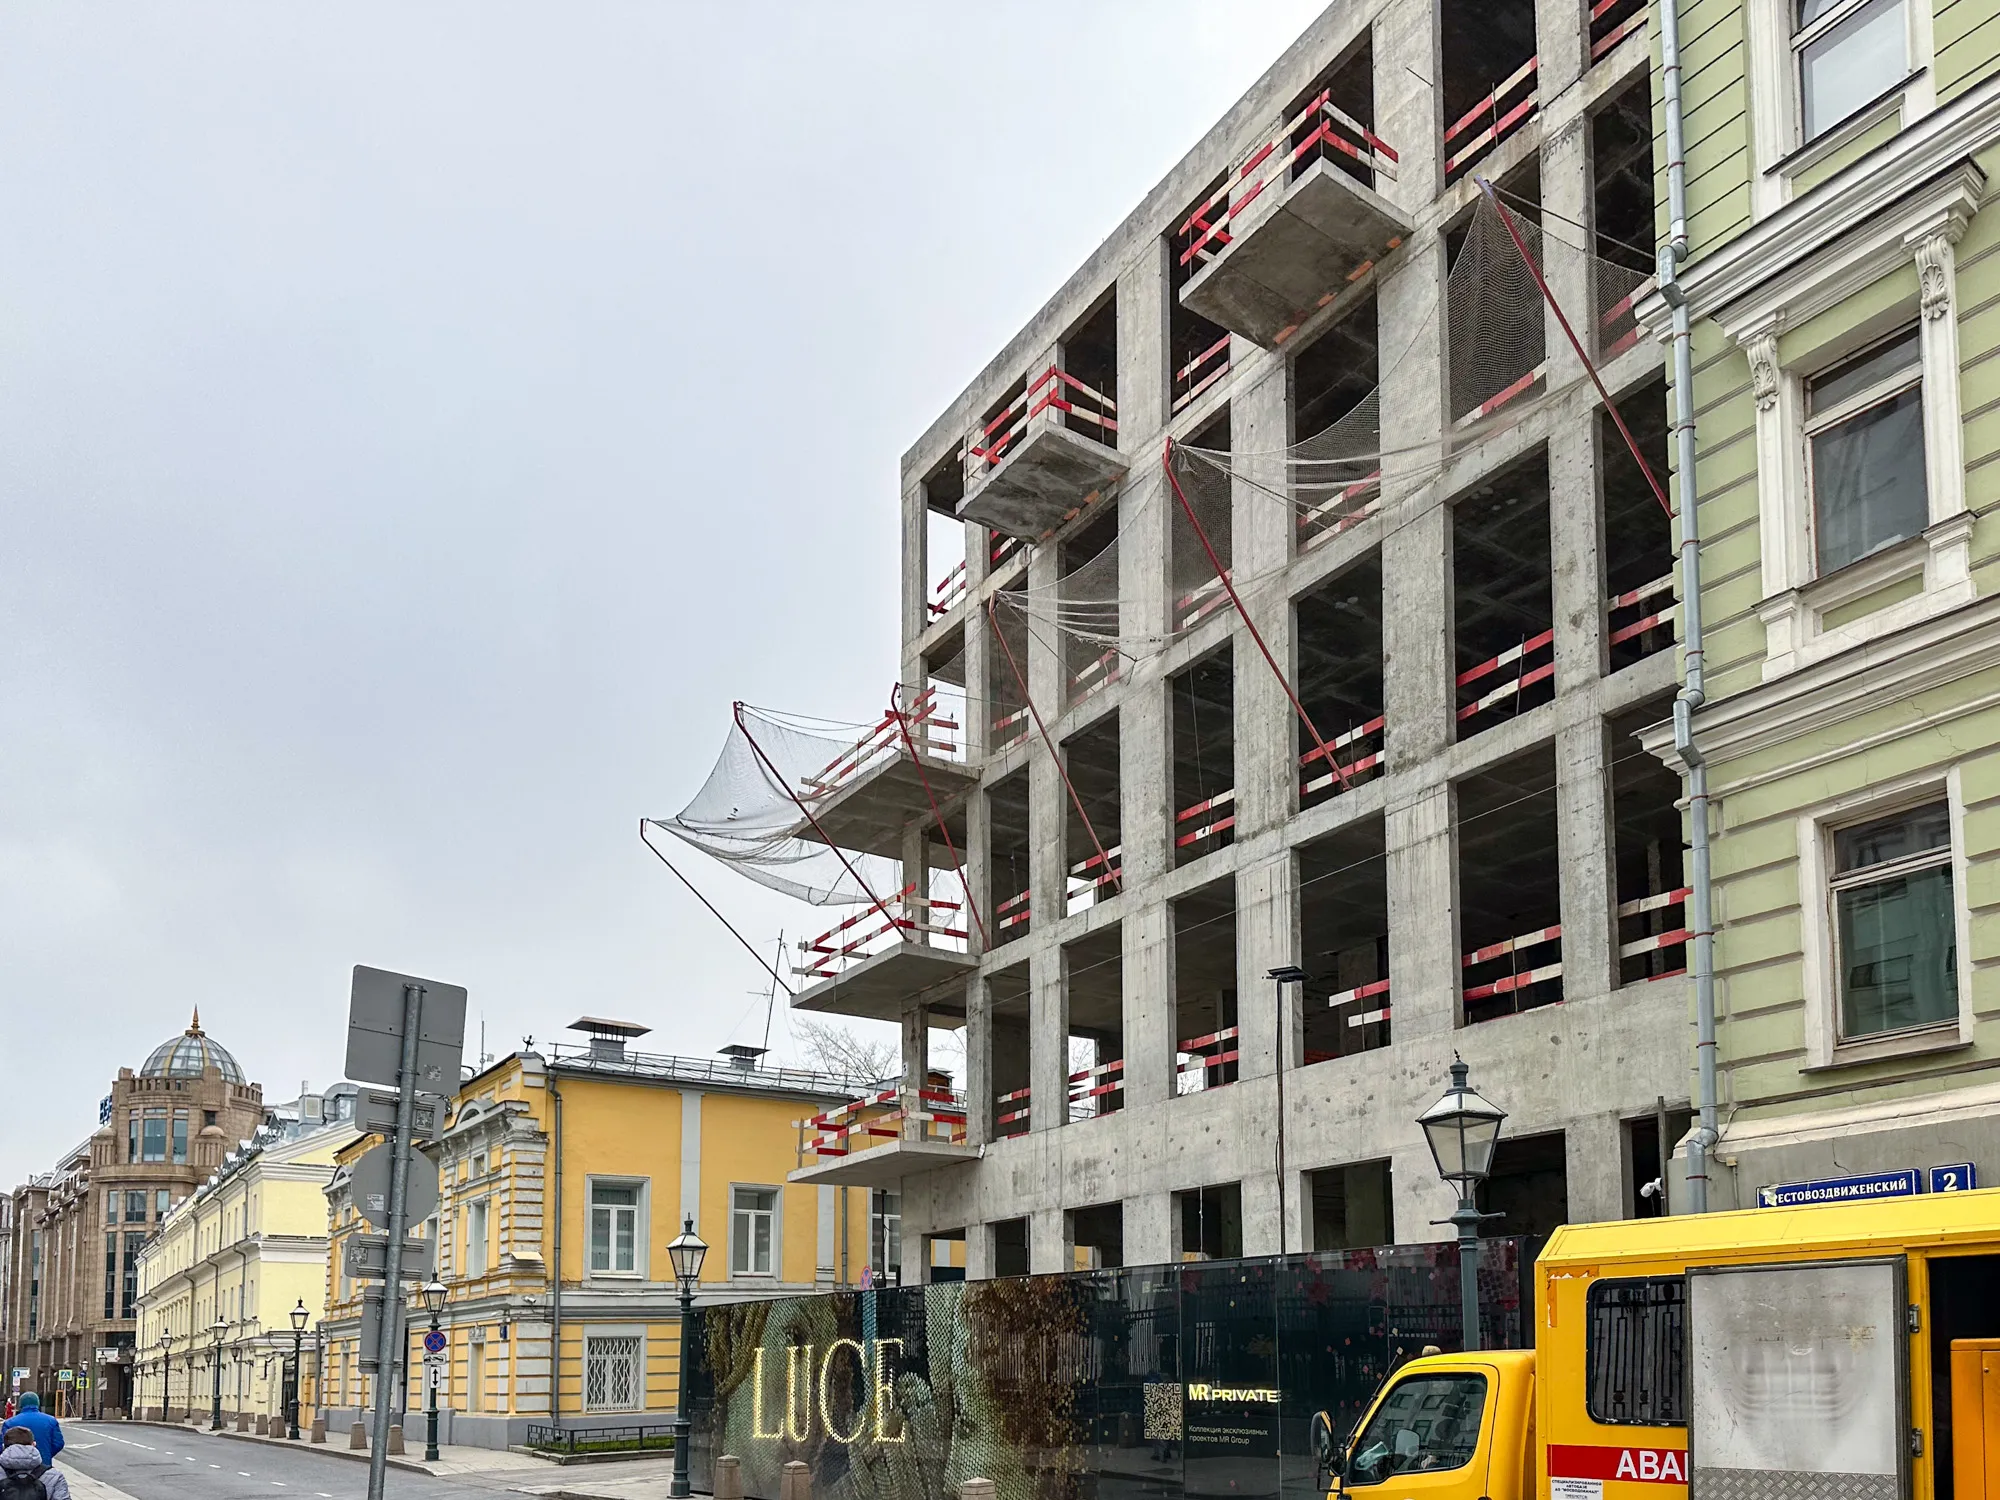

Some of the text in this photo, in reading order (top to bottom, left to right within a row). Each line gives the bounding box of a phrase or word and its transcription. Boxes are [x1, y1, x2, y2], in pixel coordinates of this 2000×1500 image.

[1943, 1172, 1958, 1192] 2
[753, 1338, 906, 1444] LUCE
[1189, 1384, 1279, 1403] MR PRIVATE
[1188, 1425, 1269, 1436] Коллекция эксклюзивных
[1188, 1435, 1218, 1443] проектов
[1230, 1436, 1250, 1445] Group
